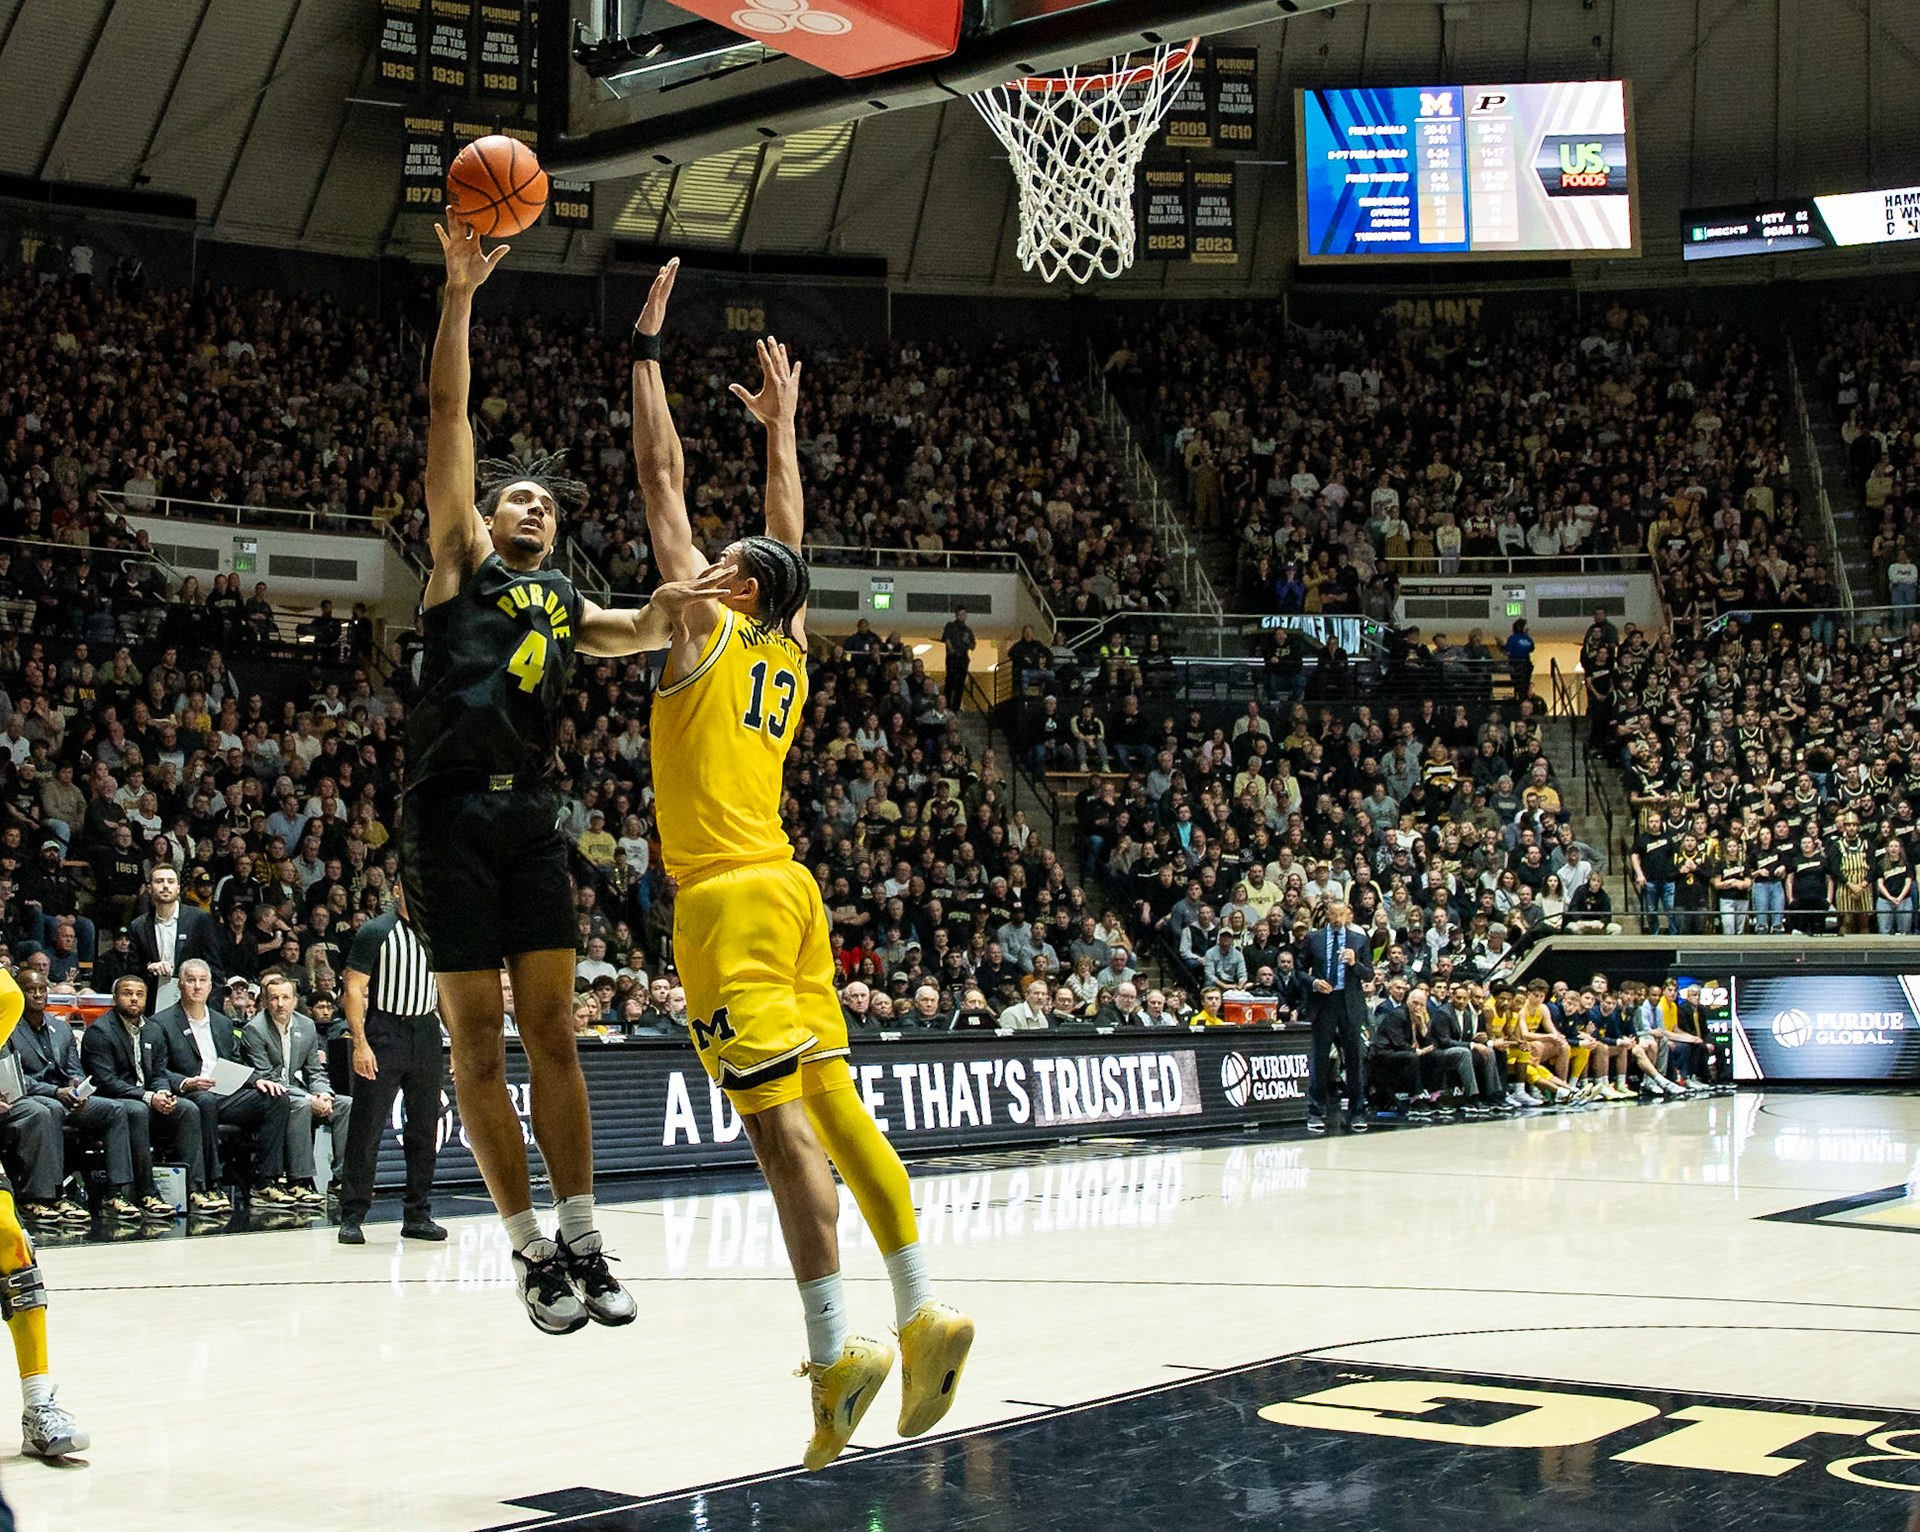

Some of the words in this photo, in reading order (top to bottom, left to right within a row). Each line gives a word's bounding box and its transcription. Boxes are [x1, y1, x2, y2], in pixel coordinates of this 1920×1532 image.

[431, 1, 470, 15] PURDUE
[482, 6, 520, 21] PURDUE
[383, 29, 397, 40] BIG
[400, 33, 416, 43] TEN
[433, 35, 447, 45] BIG
[450, 37, 466, 49] TEN
[381, 40, 417, 55] CHAMPS
[430, 45, 467, 60] CHAMPS
[484, 42, 498, 52] BIG
[501, 43, 518, 54] TEN
[482, 52, 519, 65] CHAMPS
[1216, 58, 1255, 70] PURDUE
[382, 61, 415, 80] 1935
[1188, 91, 1204, 101] TEN
[1219, 93, 1233, 103] BIG
[1236, 94, 1252, 103] TEN
[1470, 91, 1509, 115] P
[1218, 103, 1254, 114] CHAMPS
[1420, 92, 1453, 116] M
[404, 117, 444, 132] PURDUE
[1170, 122, 1207, 136] 2009
[1220, 124, 1252, 140] 2010
[406, 155, 421, 165] BIG
[424, 155, 441, 165] TEN
[404, 165, 442, 176] CHAMPS
[1146, 171, 1185, 183] PURDUE
[1194, 172, 1233, 184] PURDUE
[1561, 173, 1607, 187] FOODS
[553, 180, 591, 192] CHAMPS
[406, 188, 442, 202] 1979
[1149, 205, 1164, 214] BIG
[1166, 205, 1183, 214] TEN
[1197, 207, 1211, 216] BIG
[1214, 207, 1231, 216] TEN
[1148, 215, 1185, 224] CHAMPS
[1195, 216, 1233, 226] CHAMPS
[1148, 235, 1186, 249] 2023
[1196, 237, 1233, 252] 2023
[725, 307, 765, 332] 103
[1396, 299, 1482, 328] PAINT
[496, 583, 571, 640] PURDUE
[507, 629, 547, 694] 4
[741, 660, 797, 739] 13
[116, 861, 138, 875] 1869
[1815, 1012, 1905, 1031] PURDUE
[691, 1005, 738, 1053] M
[1250, 1054, 1311, 1080] PURDUE
[893, 1060, 1030, 1131] THAT'S
[1033, 1055, 1183, 1121] TRUSTED
[662, 1071, 701, 1146] A
